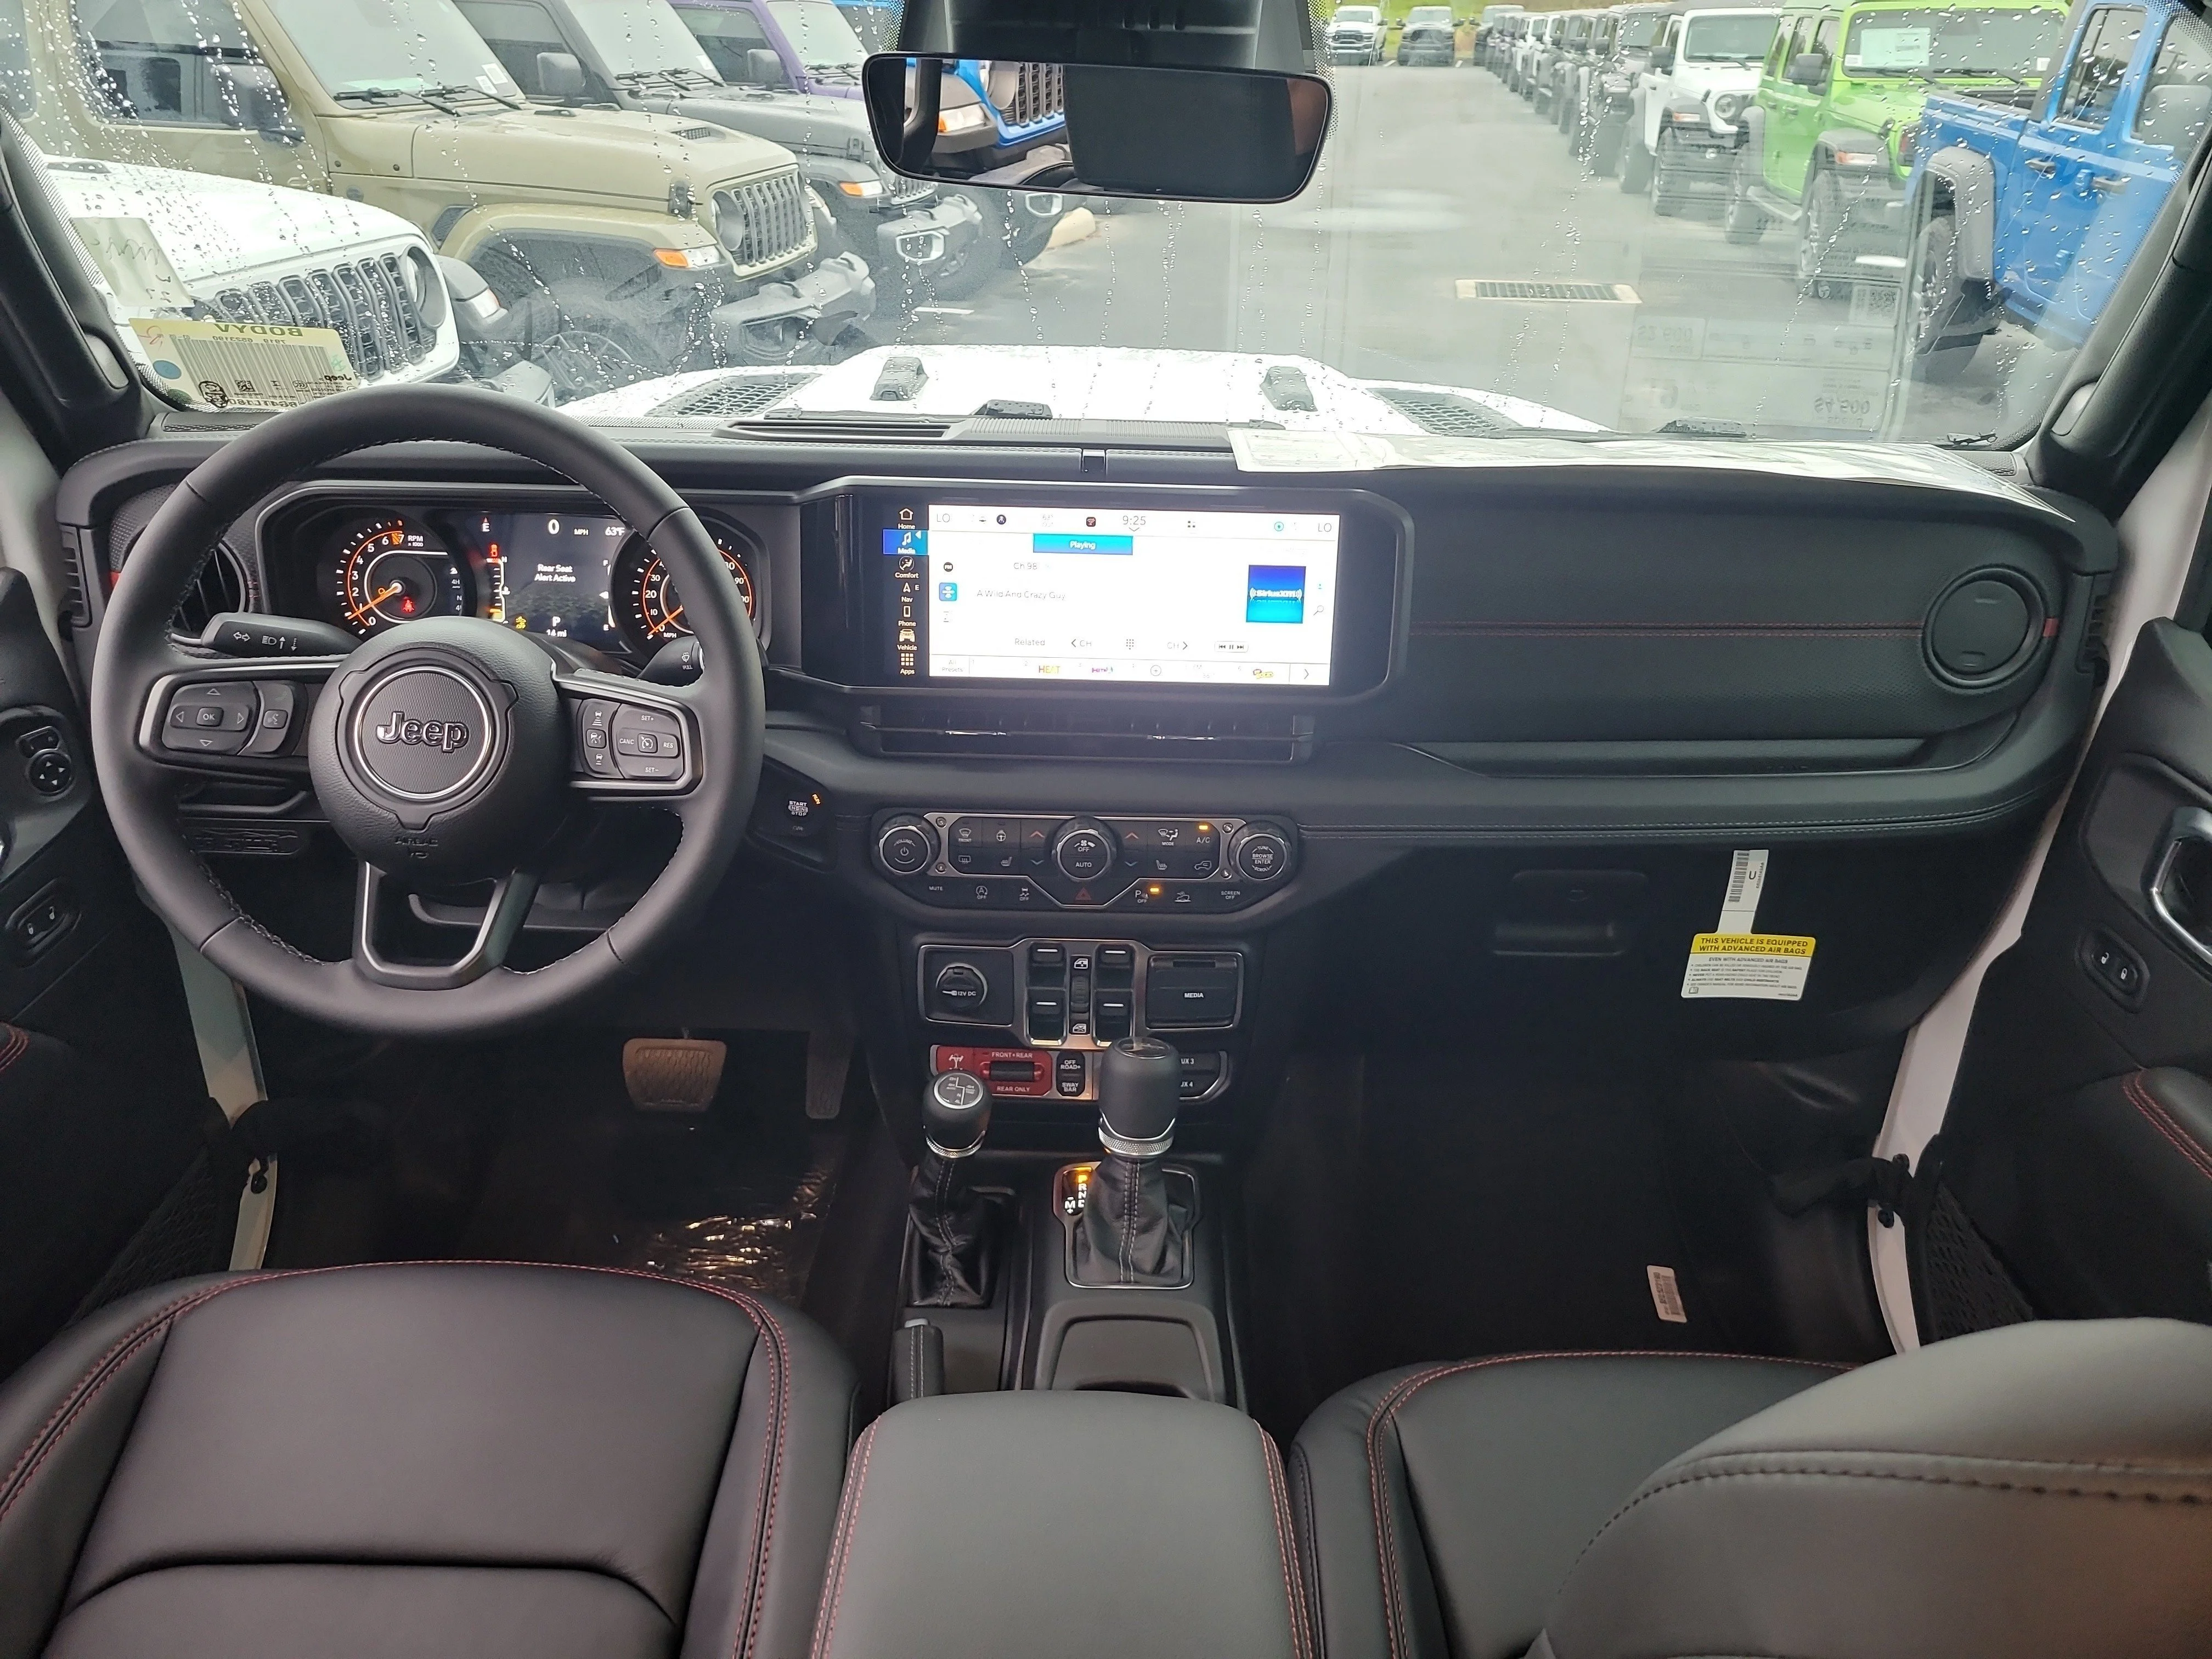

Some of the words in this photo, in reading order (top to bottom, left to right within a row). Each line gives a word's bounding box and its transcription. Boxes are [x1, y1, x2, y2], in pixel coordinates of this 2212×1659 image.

[482, 522, 489, 532] E
[549, 520, 560, 534] 0
[936, 514, 950, 522] LO
[1122, 515, 1146, 525] 9:25
[1318, 523, 1332, 532] LO
[382, 537, 389, 545] 6
[398, 534, 405, 543] 7
[368, 544, 375, 552] 5
[1069, 540, 1096, 550] Playing
[357, 556, 364, 564] 4
[538, 564, 554, 572] Rear
[555, 565, 573, 573] Seat
[352, 571, 358, 580] 3
[553, 574, 576, 583] Active
[352, 588, 359, 596] 2
[645, 590, 657, 599] 20
[1024, 591, 1047, 600] Crazy
[1049, 591, 1066, 601] Guy
[369, 617, 376, 625] 0
[552, 616, 561, 627] P
[375, 710, 470, 753] Jeep
[1767, 939, 1808, 947] EQUIPPED
[1078, 1191, 1087, 1199] N
[1064, 1200, 1076, 1209] M
